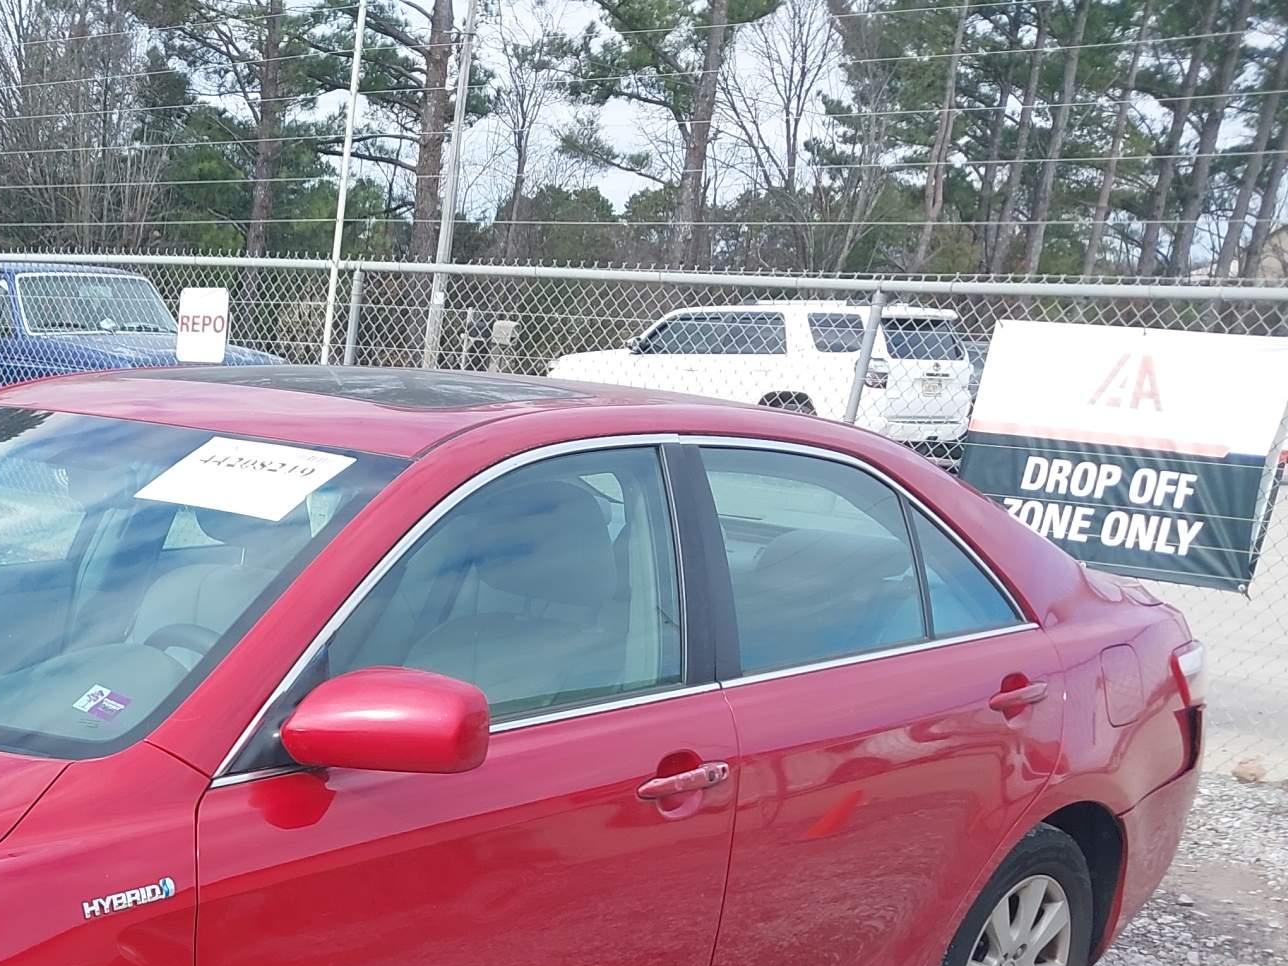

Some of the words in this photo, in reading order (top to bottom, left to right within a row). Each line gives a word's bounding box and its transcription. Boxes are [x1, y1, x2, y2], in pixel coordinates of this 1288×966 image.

[180, 315, 225, 333] REPO
[1020, 455, 1122, 499] DROP
[1128, 468, 1198, 510] OFF
[1100, 511, 1204, 556] ONLY
[82, 884, 165, 919] HYBRID
